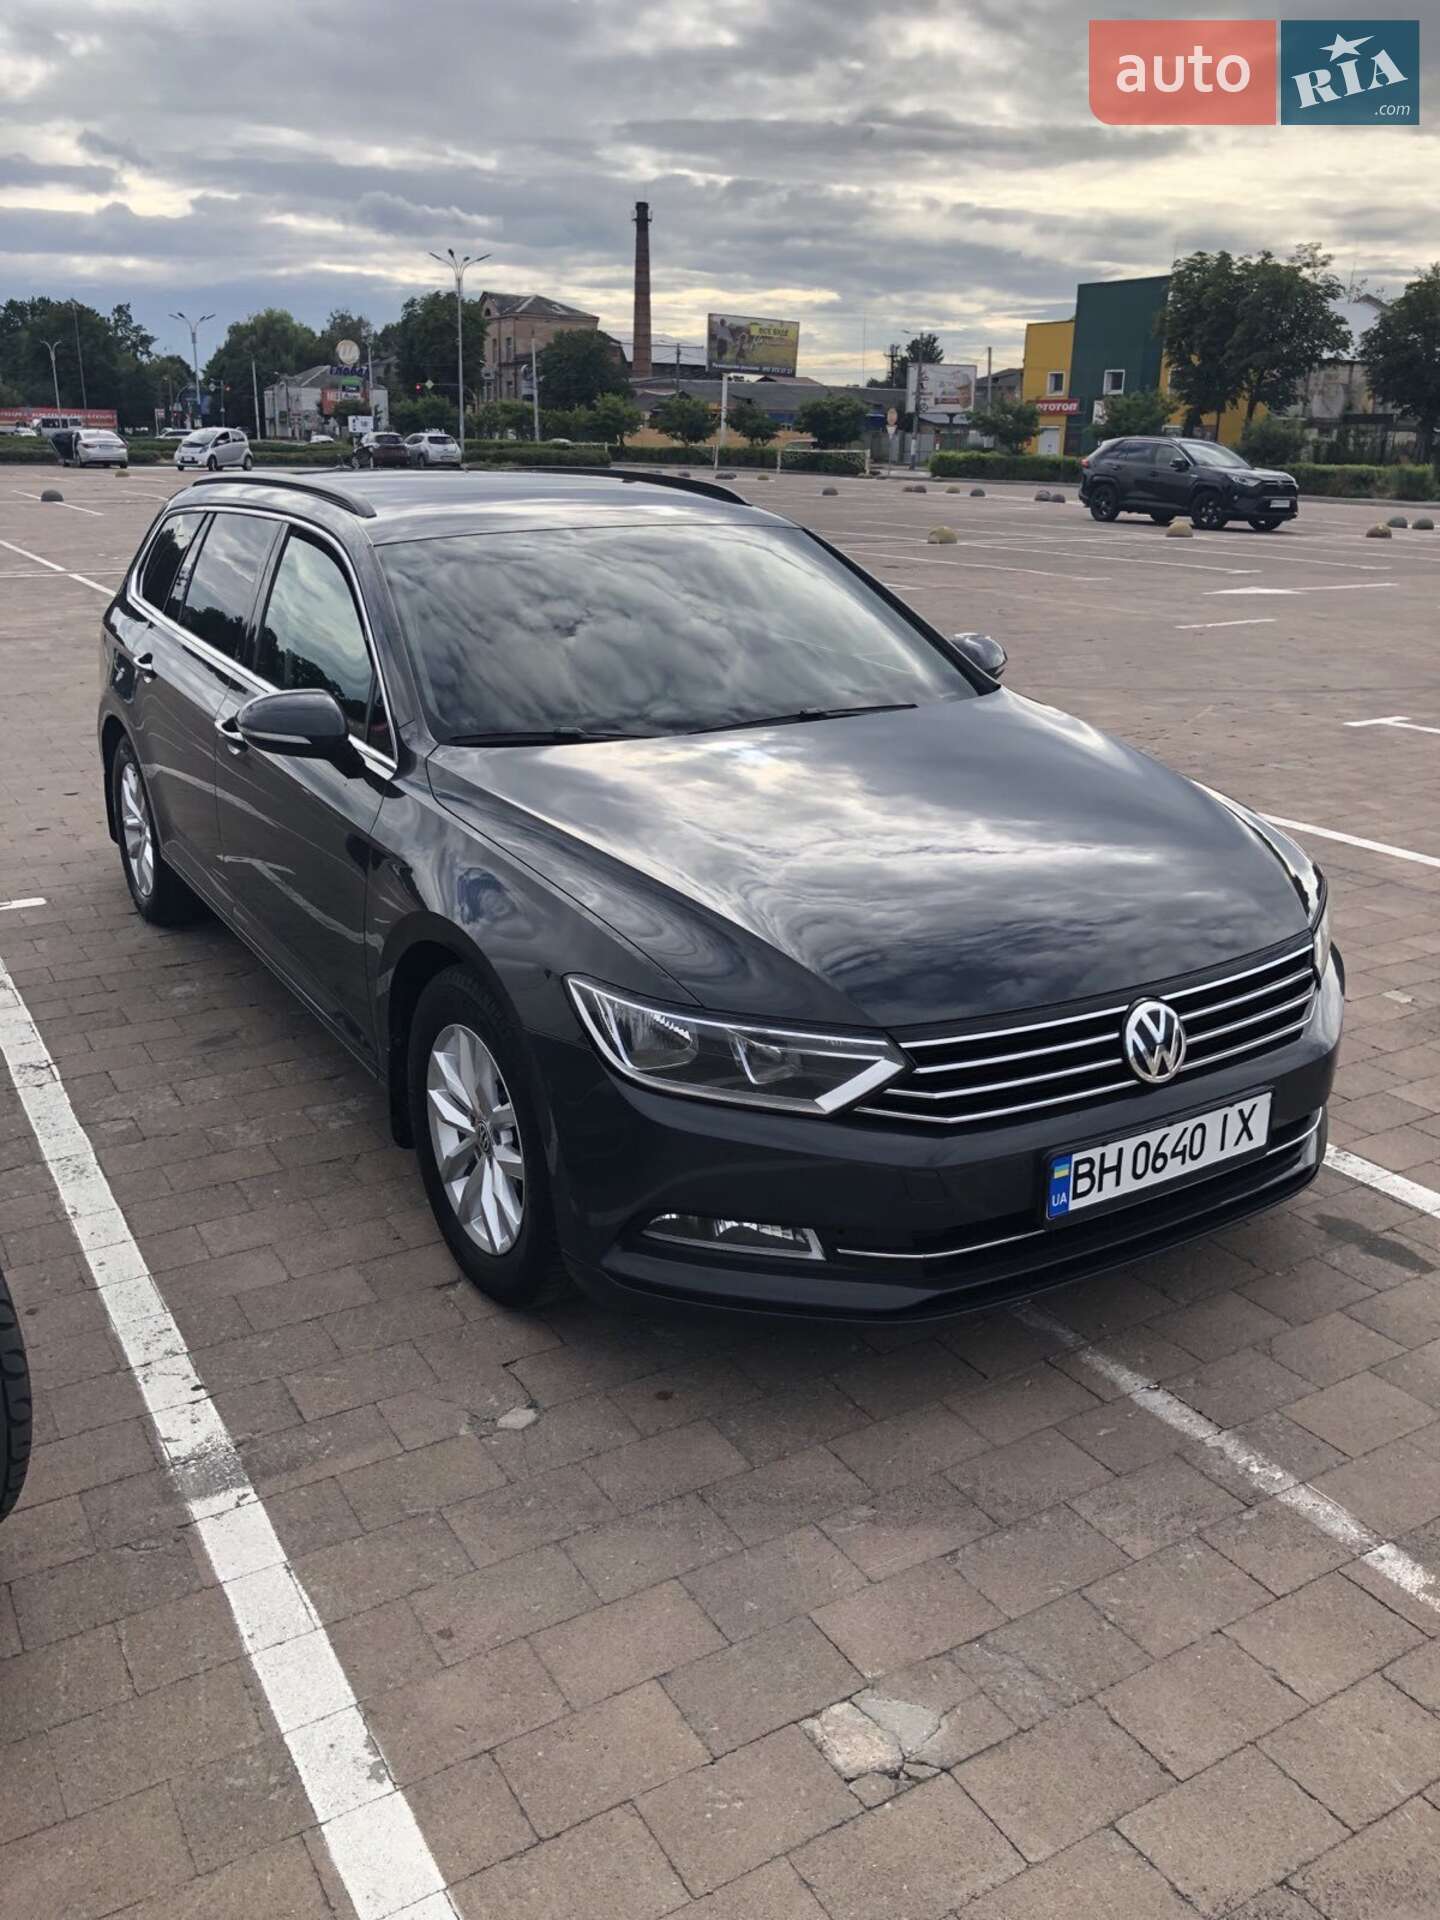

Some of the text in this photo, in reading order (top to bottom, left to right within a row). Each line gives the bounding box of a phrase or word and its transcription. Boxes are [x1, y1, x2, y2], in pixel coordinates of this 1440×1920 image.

[1072, 1147, 1124, 1201] BH
[1131, 1122, 1207, 1180] 0640
[1051, 1192, 1068, 1207] UA
